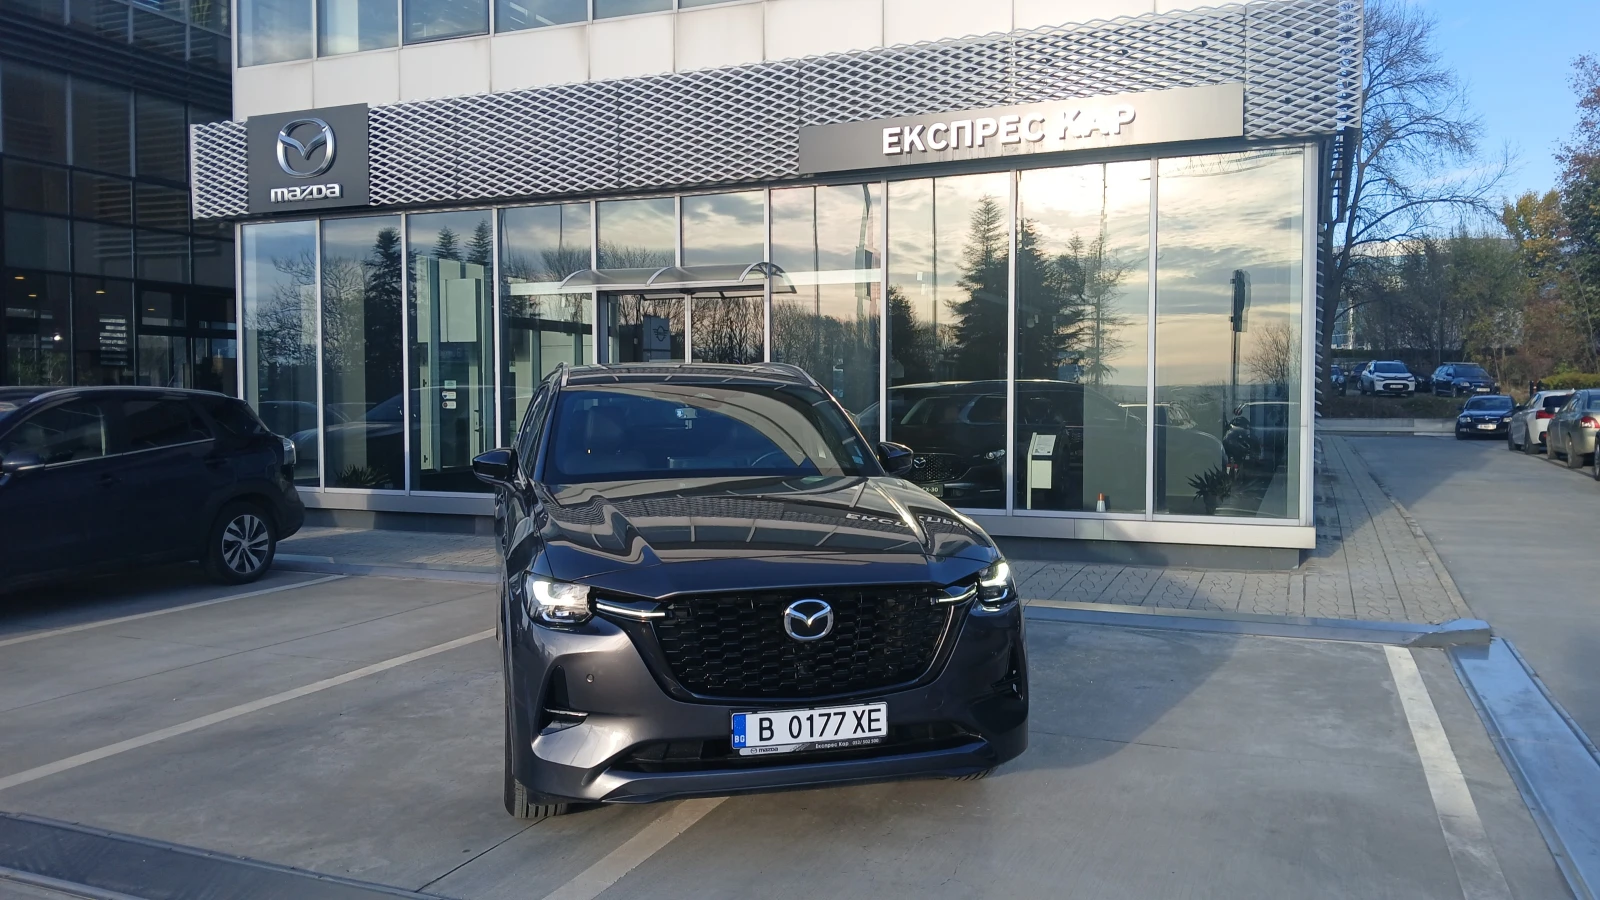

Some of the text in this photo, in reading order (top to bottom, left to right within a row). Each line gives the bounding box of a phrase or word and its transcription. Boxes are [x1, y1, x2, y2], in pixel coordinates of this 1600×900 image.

[882, 103, 1136, 156] ЕКСПРЕС КАР
[734, 735, 745, 743] BG
[788, 711, 847, 739] 0177
